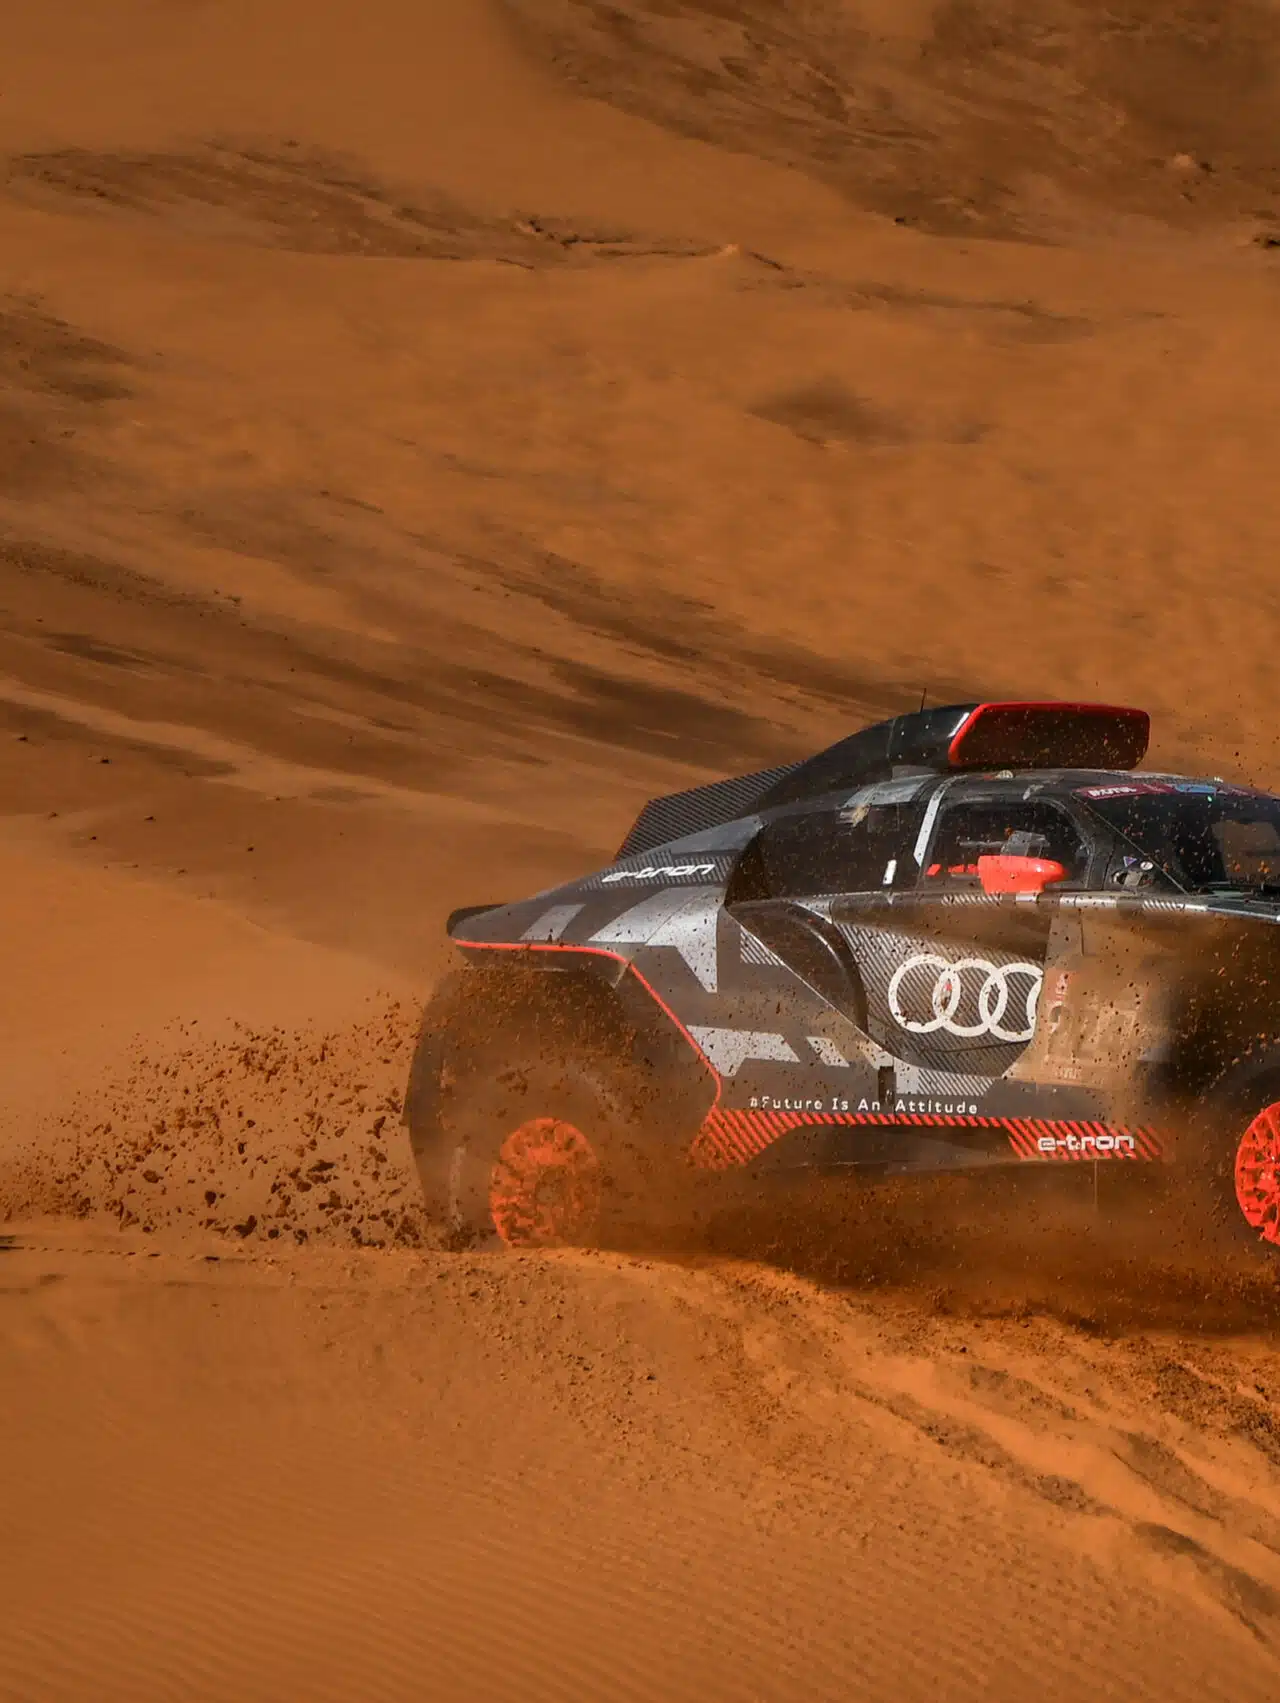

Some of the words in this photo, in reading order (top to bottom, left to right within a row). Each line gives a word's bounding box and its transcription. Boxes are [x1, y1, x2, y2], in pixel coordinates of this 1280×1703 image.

[602, 864, 716, 883] e-tron
[832, 1098, 849, 1111] Is
[857, 1098, 881, 1111] An
[895, 1099, 978, 1114] Attitude
[1037, 1134, 1135, 1151] e-tron
